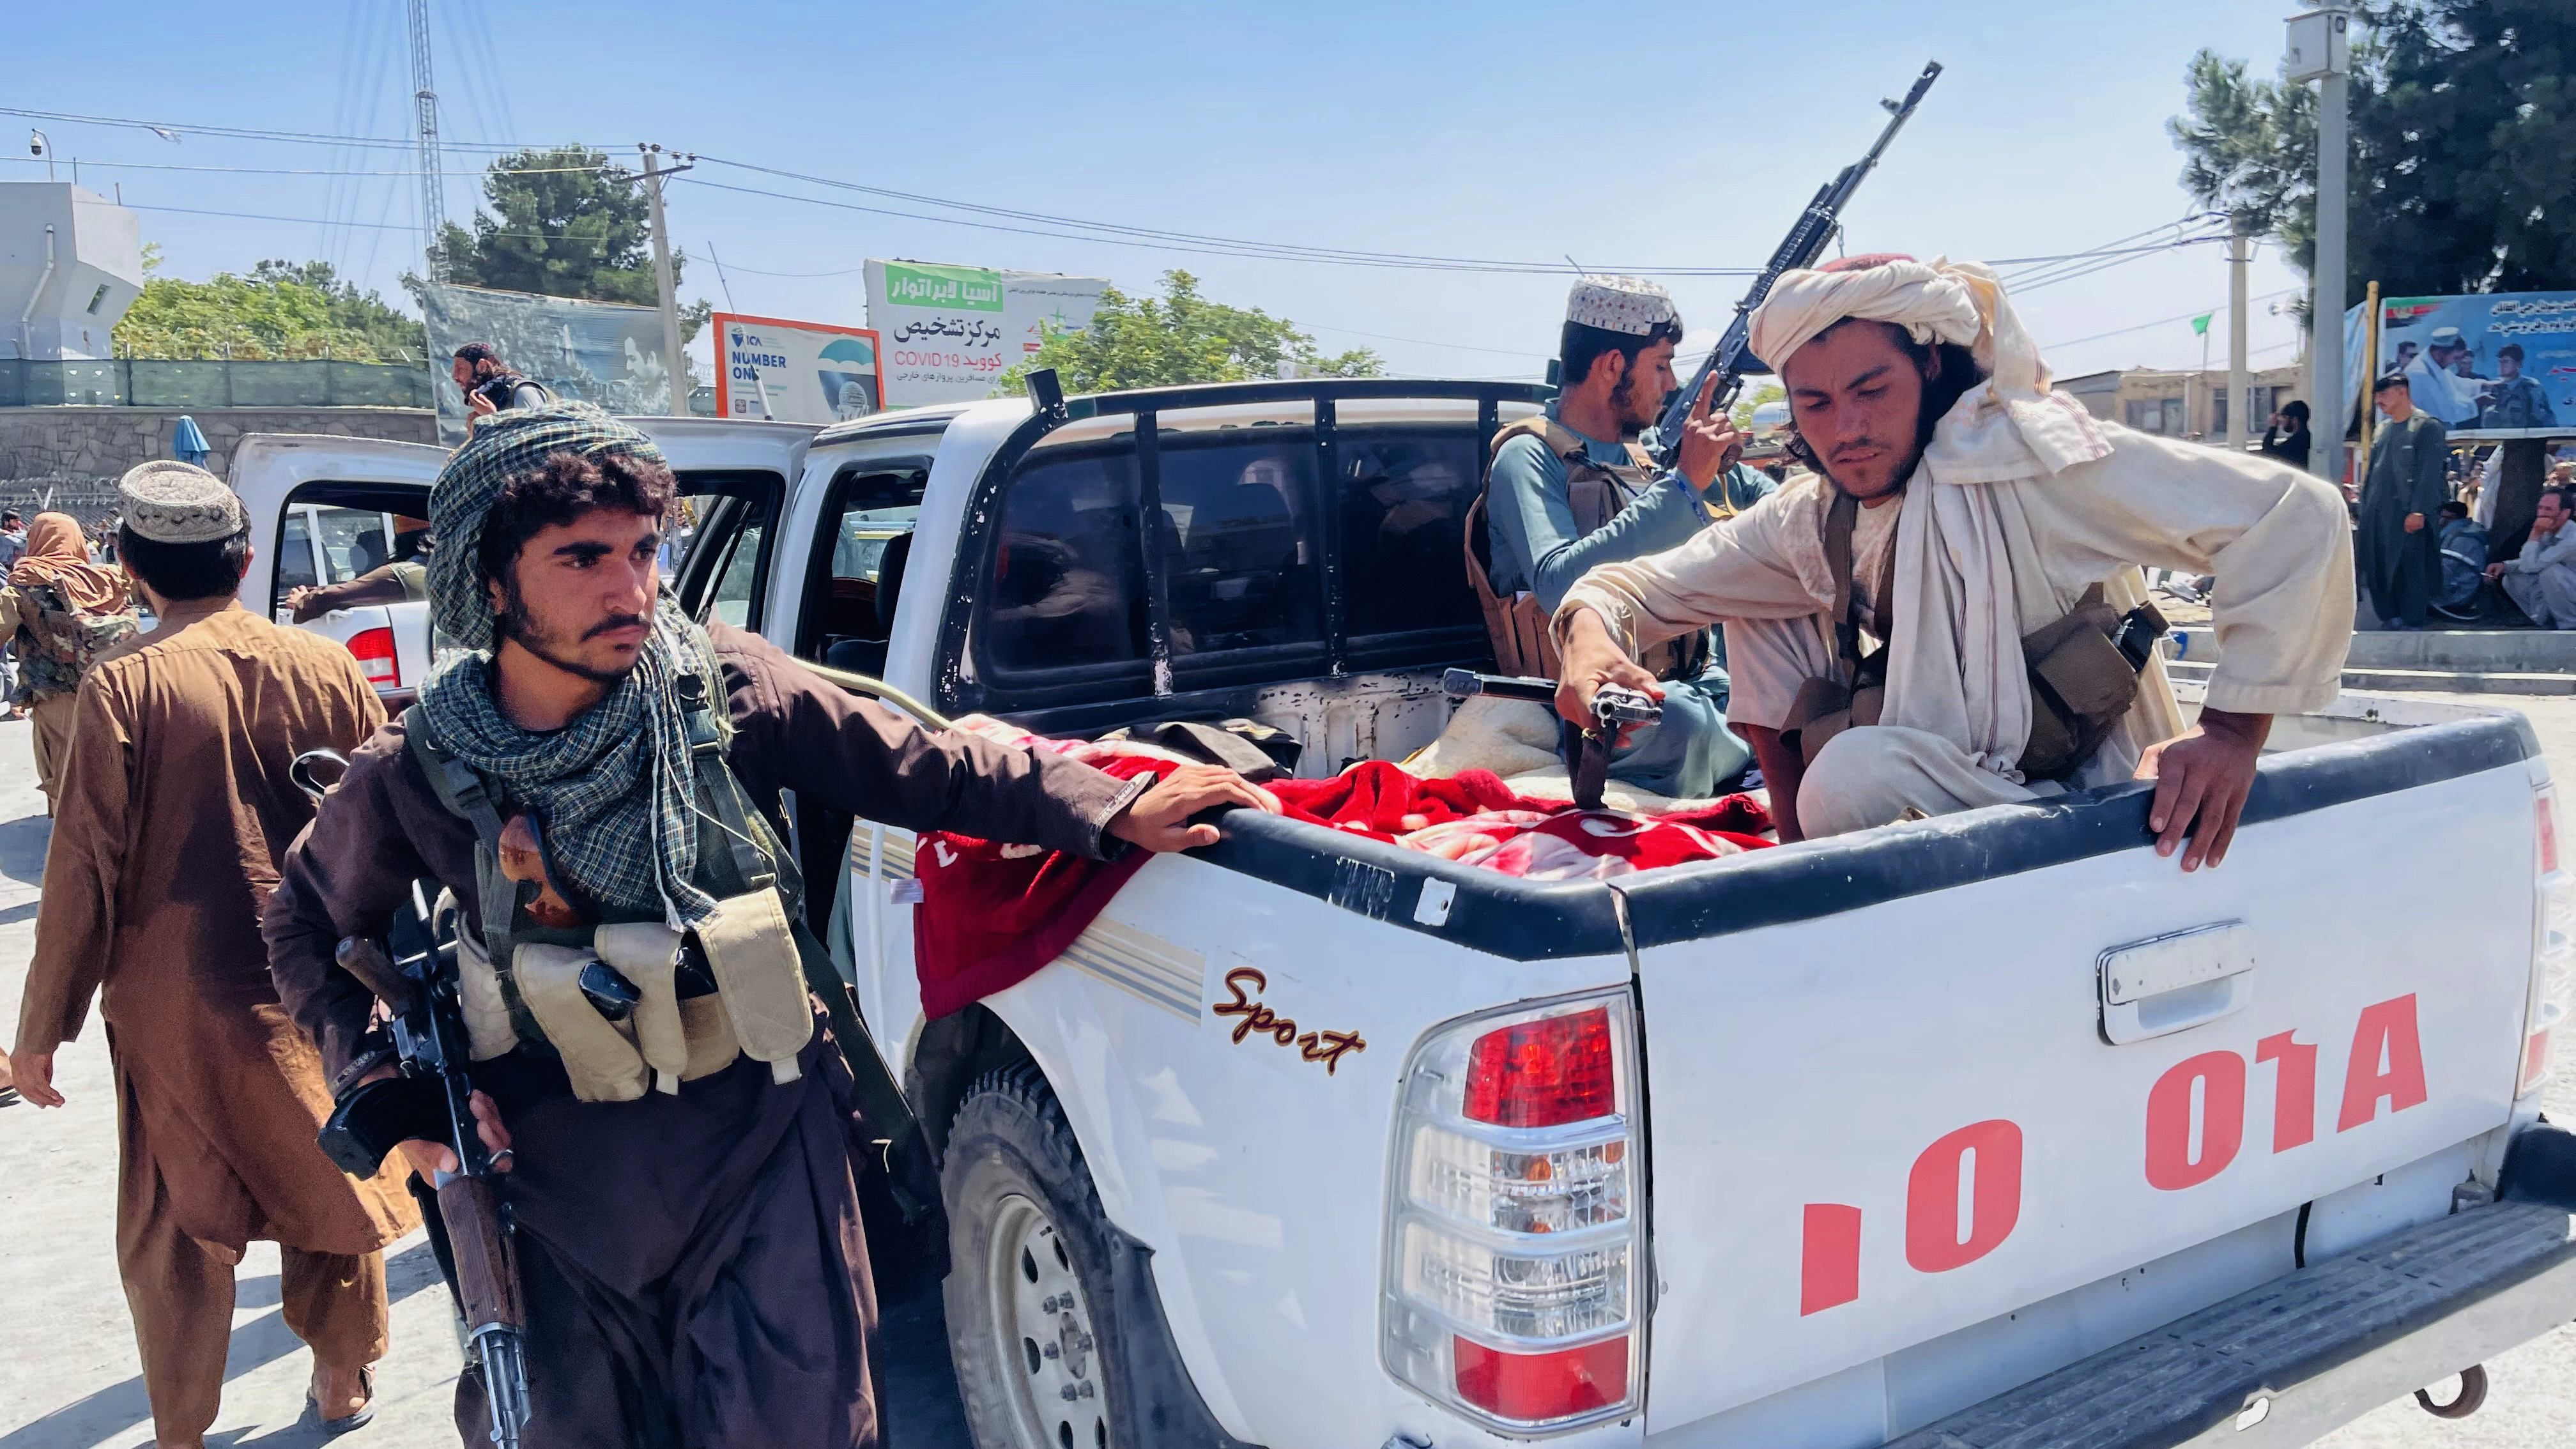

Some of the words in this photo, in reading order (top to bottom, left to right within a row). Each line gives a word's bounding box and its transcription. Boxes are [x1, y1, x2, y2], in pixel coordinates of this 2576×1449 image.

[891, 277, 957, 303] لابراتوار
[746, 335, 762, 346] ICA
[894, 316, 964, 343] تشخیص
[732, 351, 786, 368] NUMBER
[1213, 967, 1367, 1076] Sport
